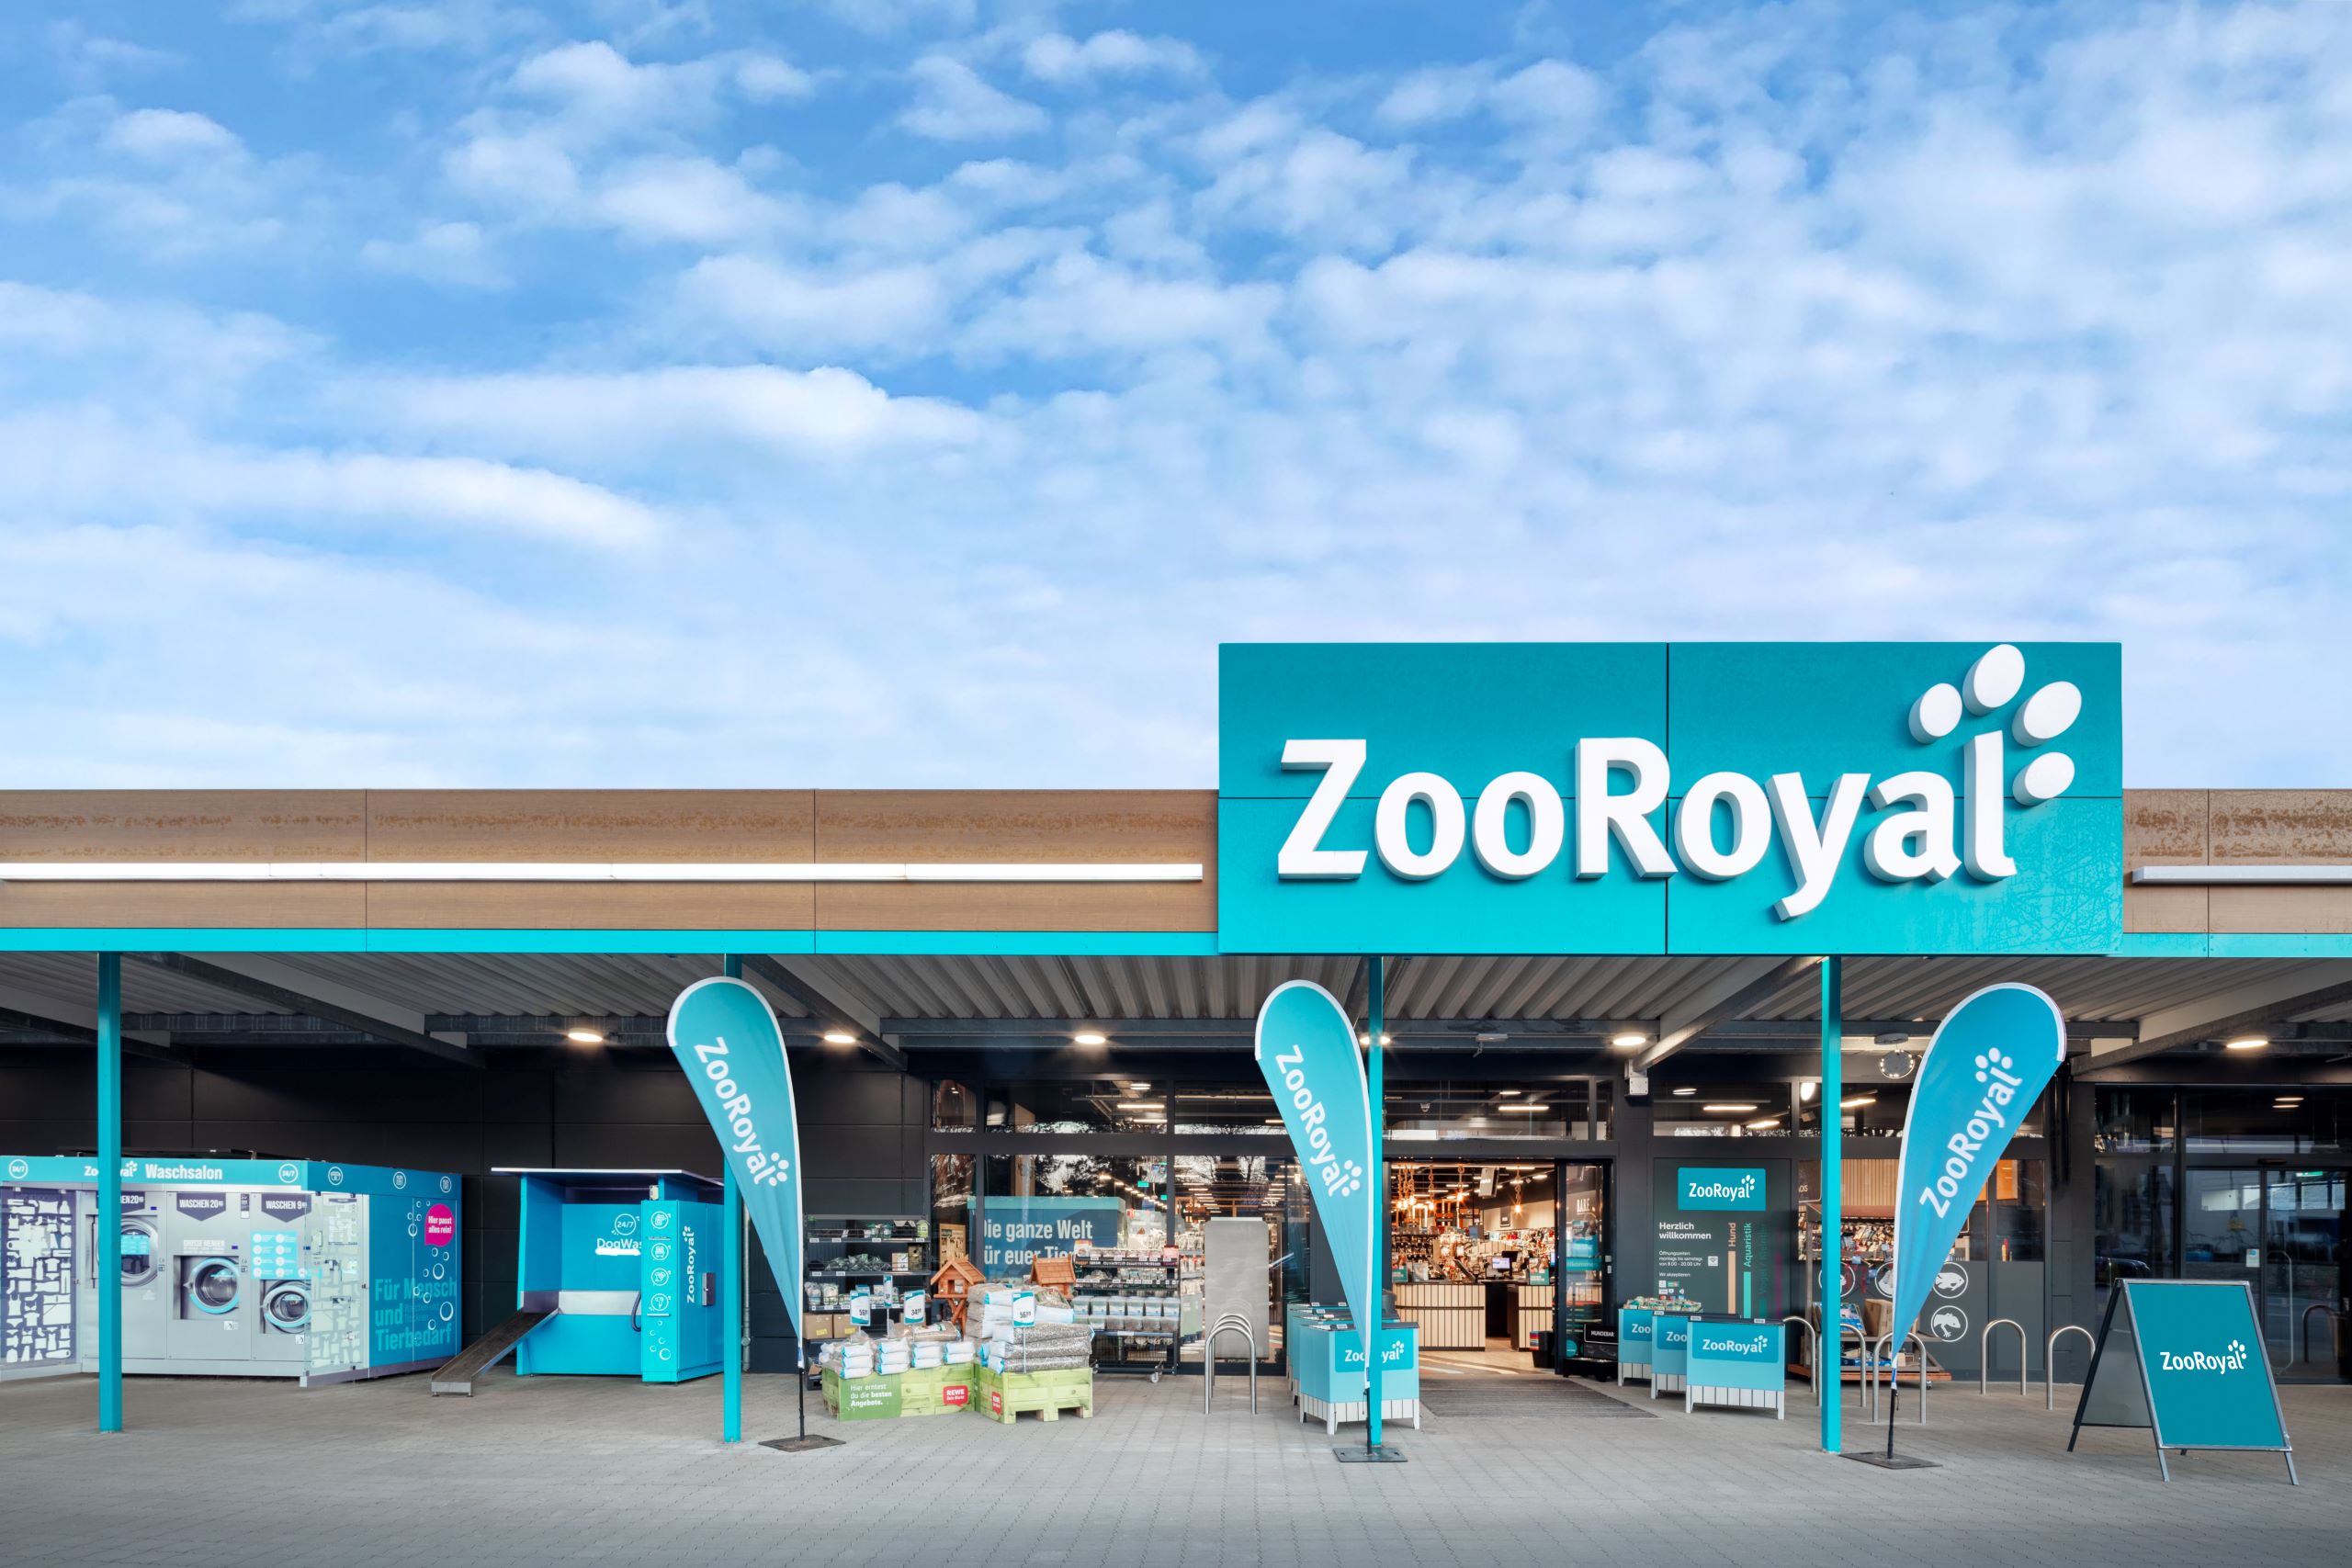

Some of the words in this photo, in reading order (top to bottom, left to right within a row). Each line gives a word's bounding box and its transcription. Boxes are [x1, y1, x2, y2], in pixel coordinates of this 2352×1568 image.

[1278, 729, 2017, 921] ZooRoyal
[694, 1037, 775, 1185] ZooRoyal
[1275, 1044, 1350, 1197] ZooRoyal
[1919, 1066, 2023, 1219] ZooRoyal
[145, 1164, 222, 1180] Waschsalon
[1689, 1182, 1750, 1202] ZooRoyal
[179, 1199, 209, 1209] WASCHEN
[266, 1200, 296, 1210] WASCHEN
[428, 1225, 440, 1234] alles
[439, 1216, 452, 1225] passt
[984, 1219, 1001, 1239] ie
[1005, 1223, 1053, 1243] ganze
[1057, 1219, 1093, 1239] Welt
[1658, 1222, 1694, 1230] Herzlich
[1658, 1231, 1712, 1240] willkommen
[1728, 1223, 1736, 1247] Hund
[1743, 1223, 1753, 1267] Aquaristik
[686, 1232, 696, 1303] ZooRoyal
[375, 1278, 401, 1302] Für
[404, 1276, 457, 1300] Mensch
[375, 1303, 403, 1326] und
[375, 1322, 452, 1351] Tierbedarf
[1702, 1338, 1762, 1355] ZooRoyal
[2160, 1350, 2244, 1375] ZooRoyal
[946, 1388, 965, 1396] REWE
